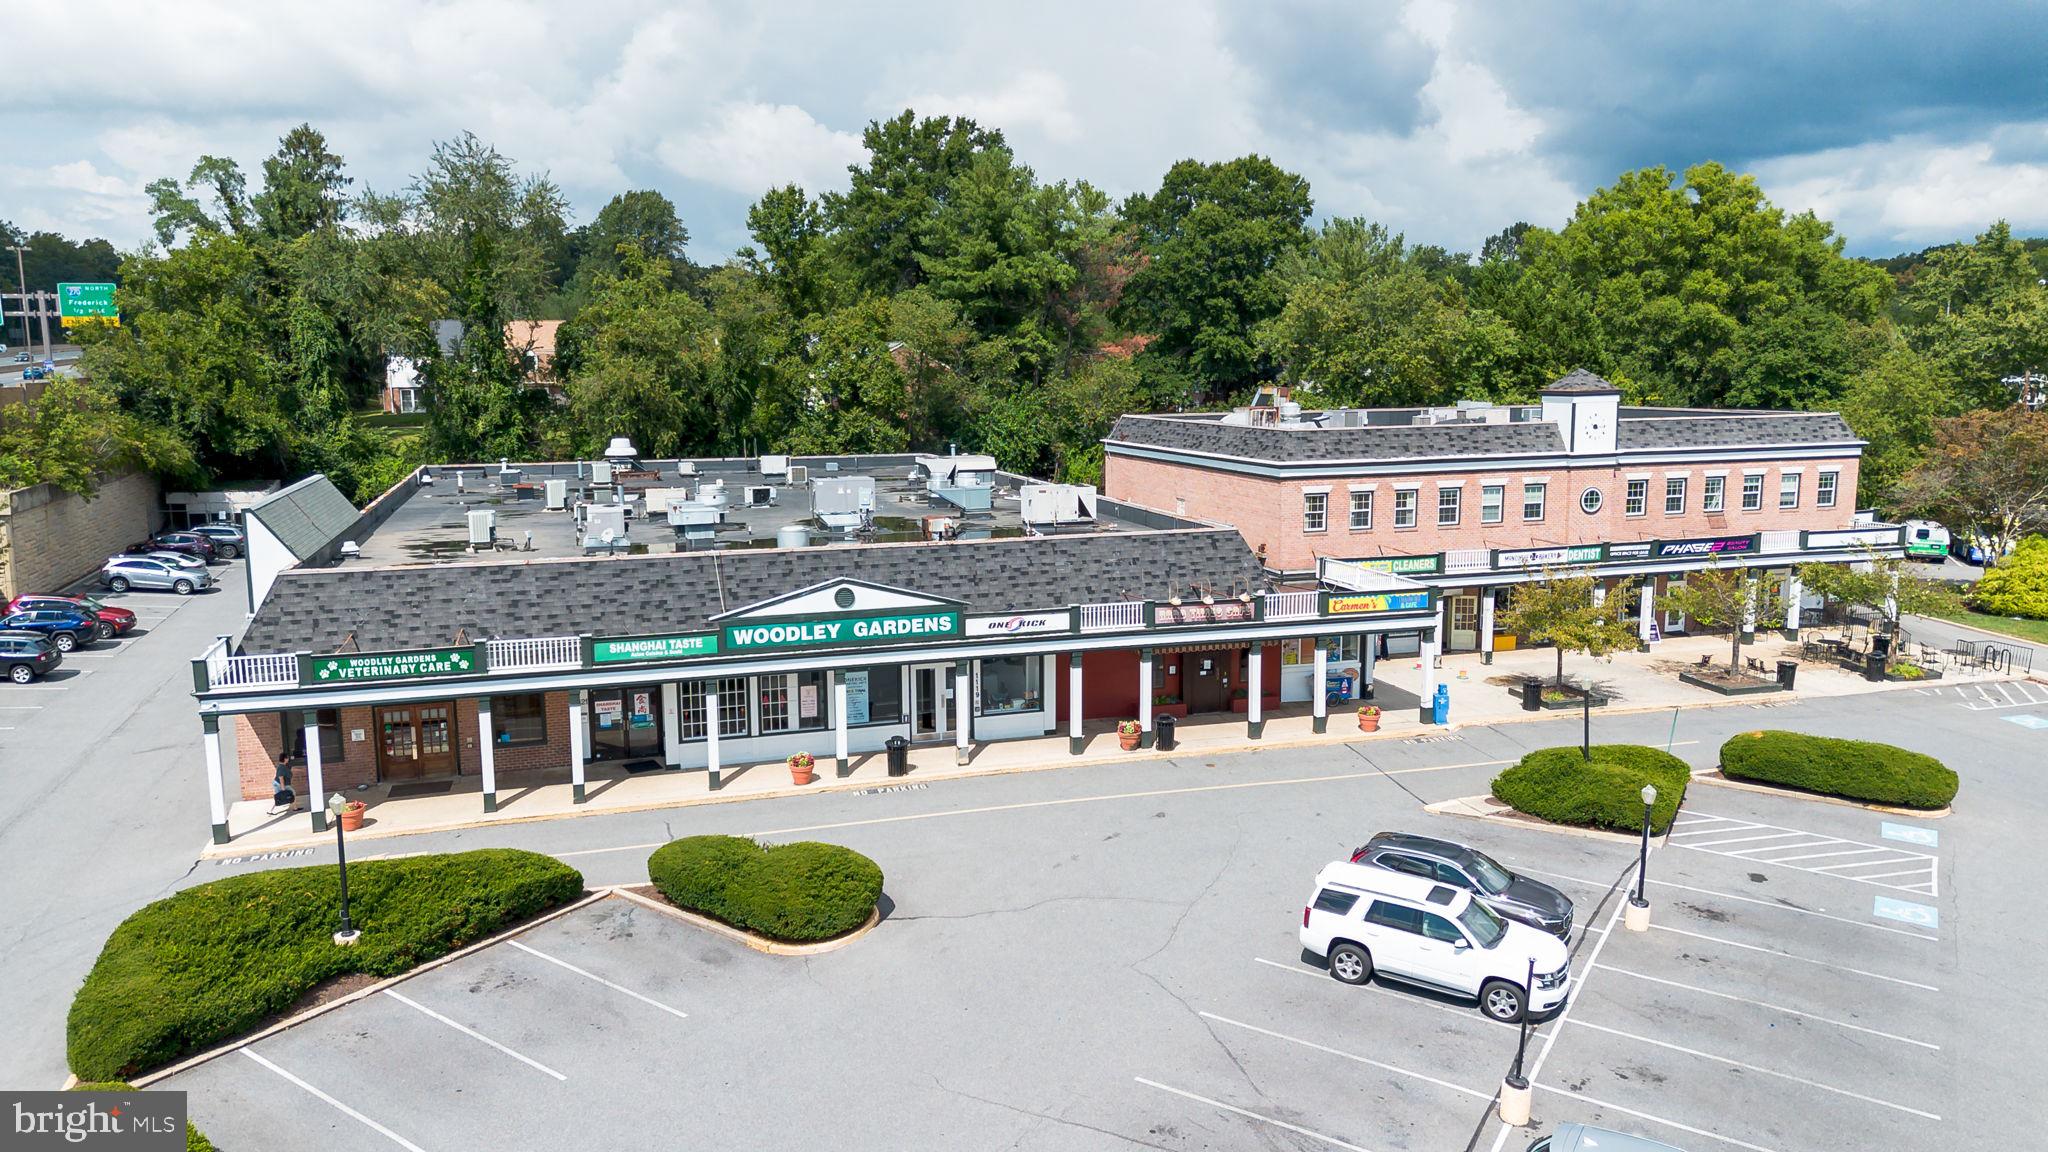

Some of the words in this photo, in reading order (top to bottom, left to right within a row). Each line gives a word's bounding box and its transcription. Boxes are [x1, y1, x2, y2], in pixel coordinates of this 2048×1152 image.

[1568, 547, 1601, 560] DENTIST
[1393, 558, 1435, 571] CLEANERS
[1332, 599, 1377, 612] Carmen's
[733, 623, 841, 645] WOODLEY
[853, 616, 952, 637] GARDENS
[988, 621, 1011, 629] ONE
[1019, 619, 1047, 627] KICK
[609, 640, 667, 654] SHANGHAI
[669, 638, 703, 649] TASTE
[350, 657, 393, 667] WOODLEY
[395, 654, 437, 664] GARDENS
[338, 664, 416, 678] VETERINARY
[420, 661, 452, 673] CARE
[877, 784, 928, 794] PARKING
[221, 858, 242, 866] NO
[249, 848, 315, 862] PARKING
